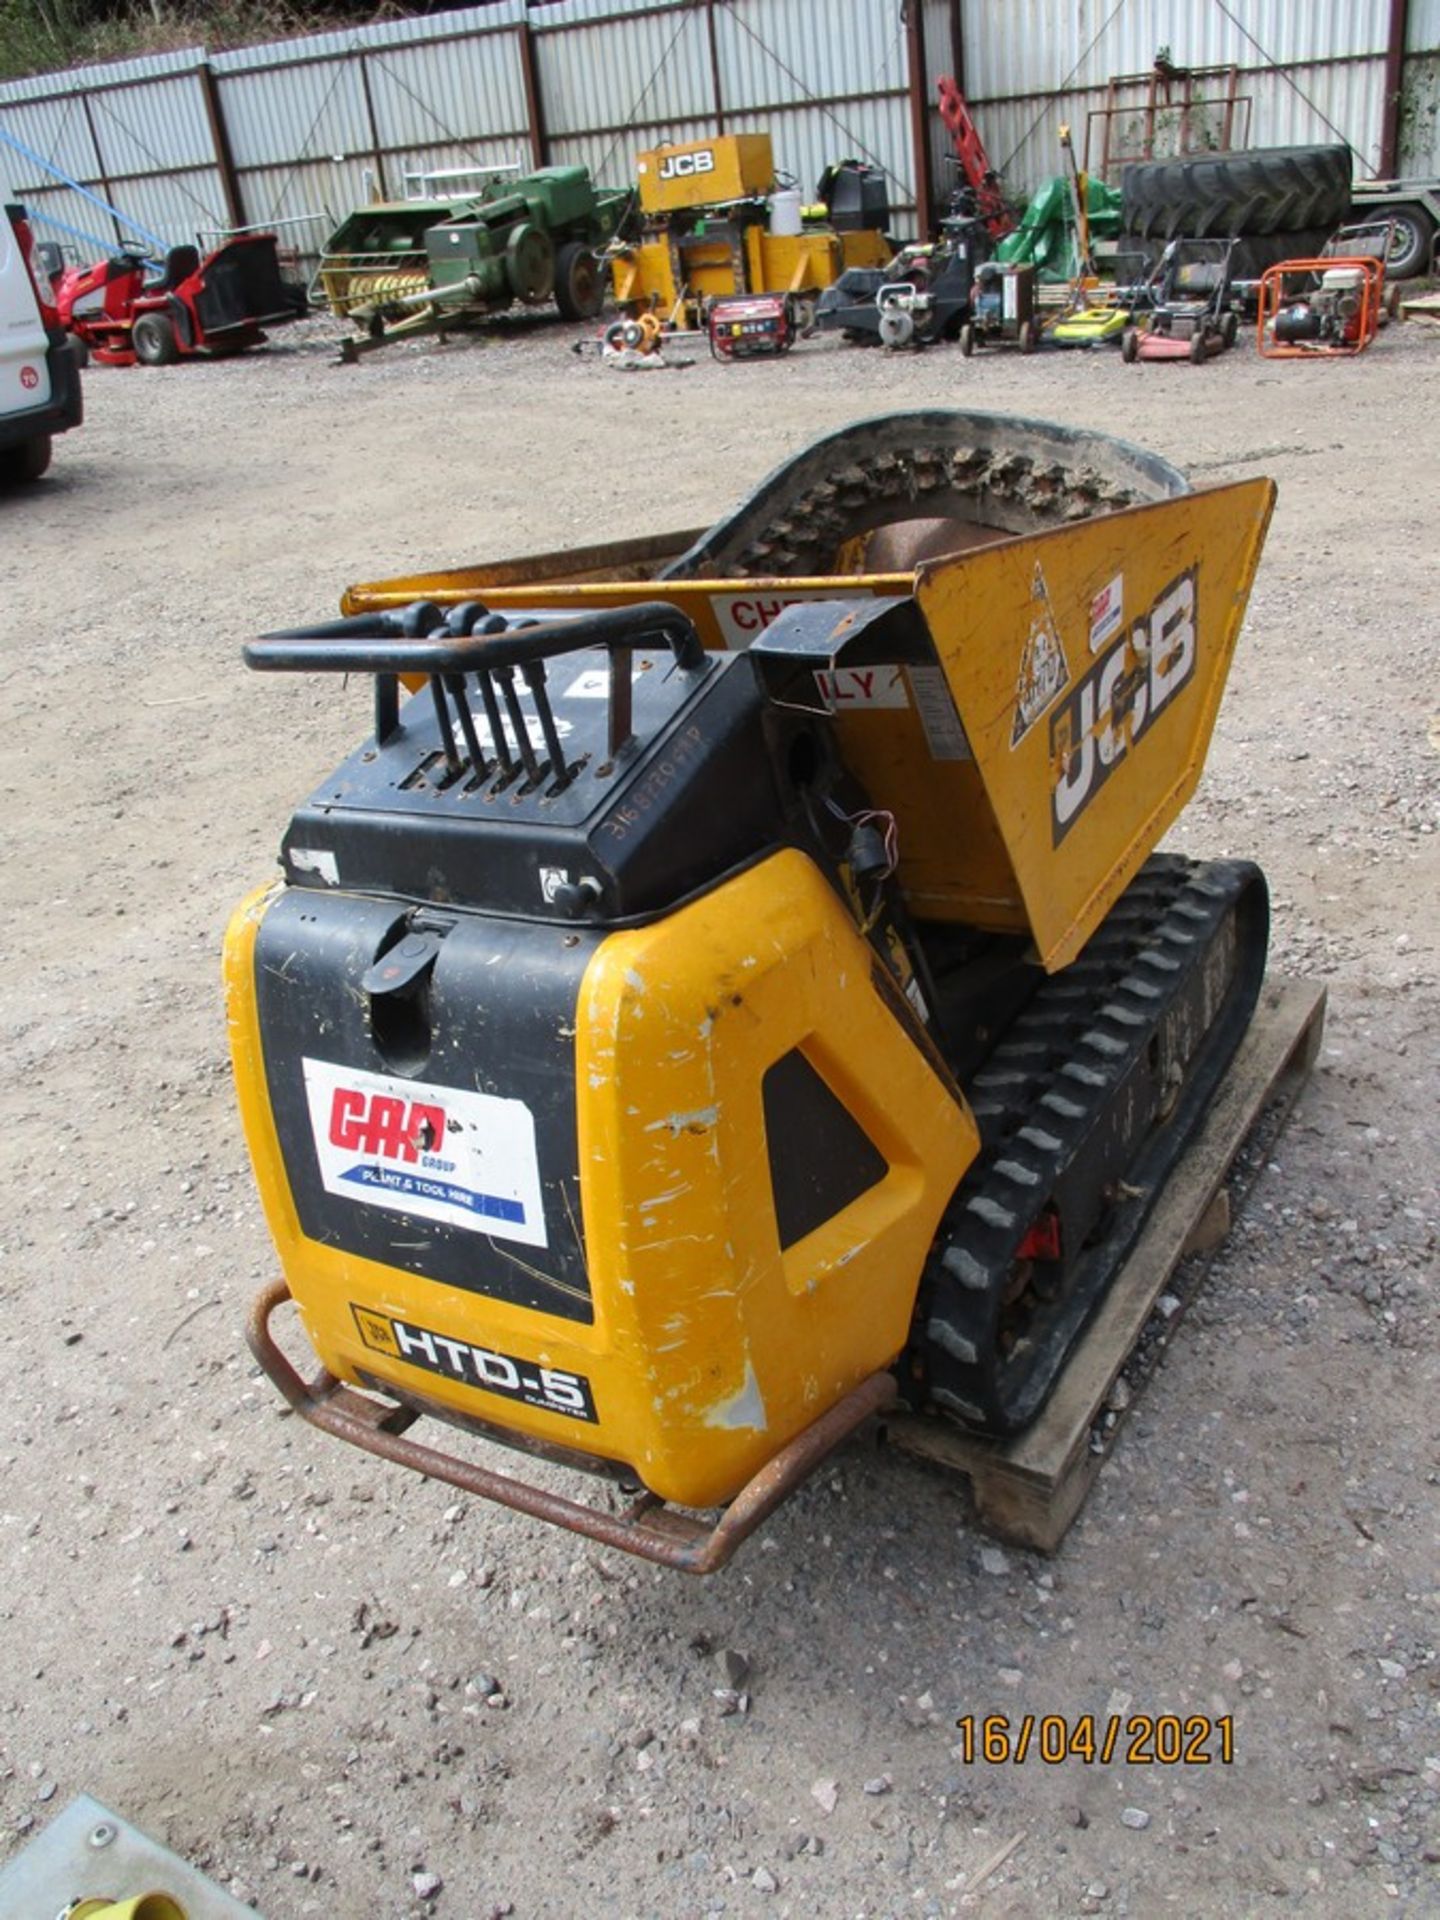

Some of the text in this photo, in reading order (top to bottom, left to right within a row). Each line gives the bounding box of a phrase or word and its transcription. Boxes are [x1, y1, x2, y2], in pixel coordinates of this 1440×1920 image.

[660, 150, 714, 179] JCB
[817, 671, 875, 700] ILY
[1055, 578, 1195, 824] JCB
[421, 1154, 457, 1173] GROUP
[415, 1179, 447, 1198] TOOL
[447, 1187, 474, 1207] HIRE
[393, 1321, 586, 1410] HTD-5
